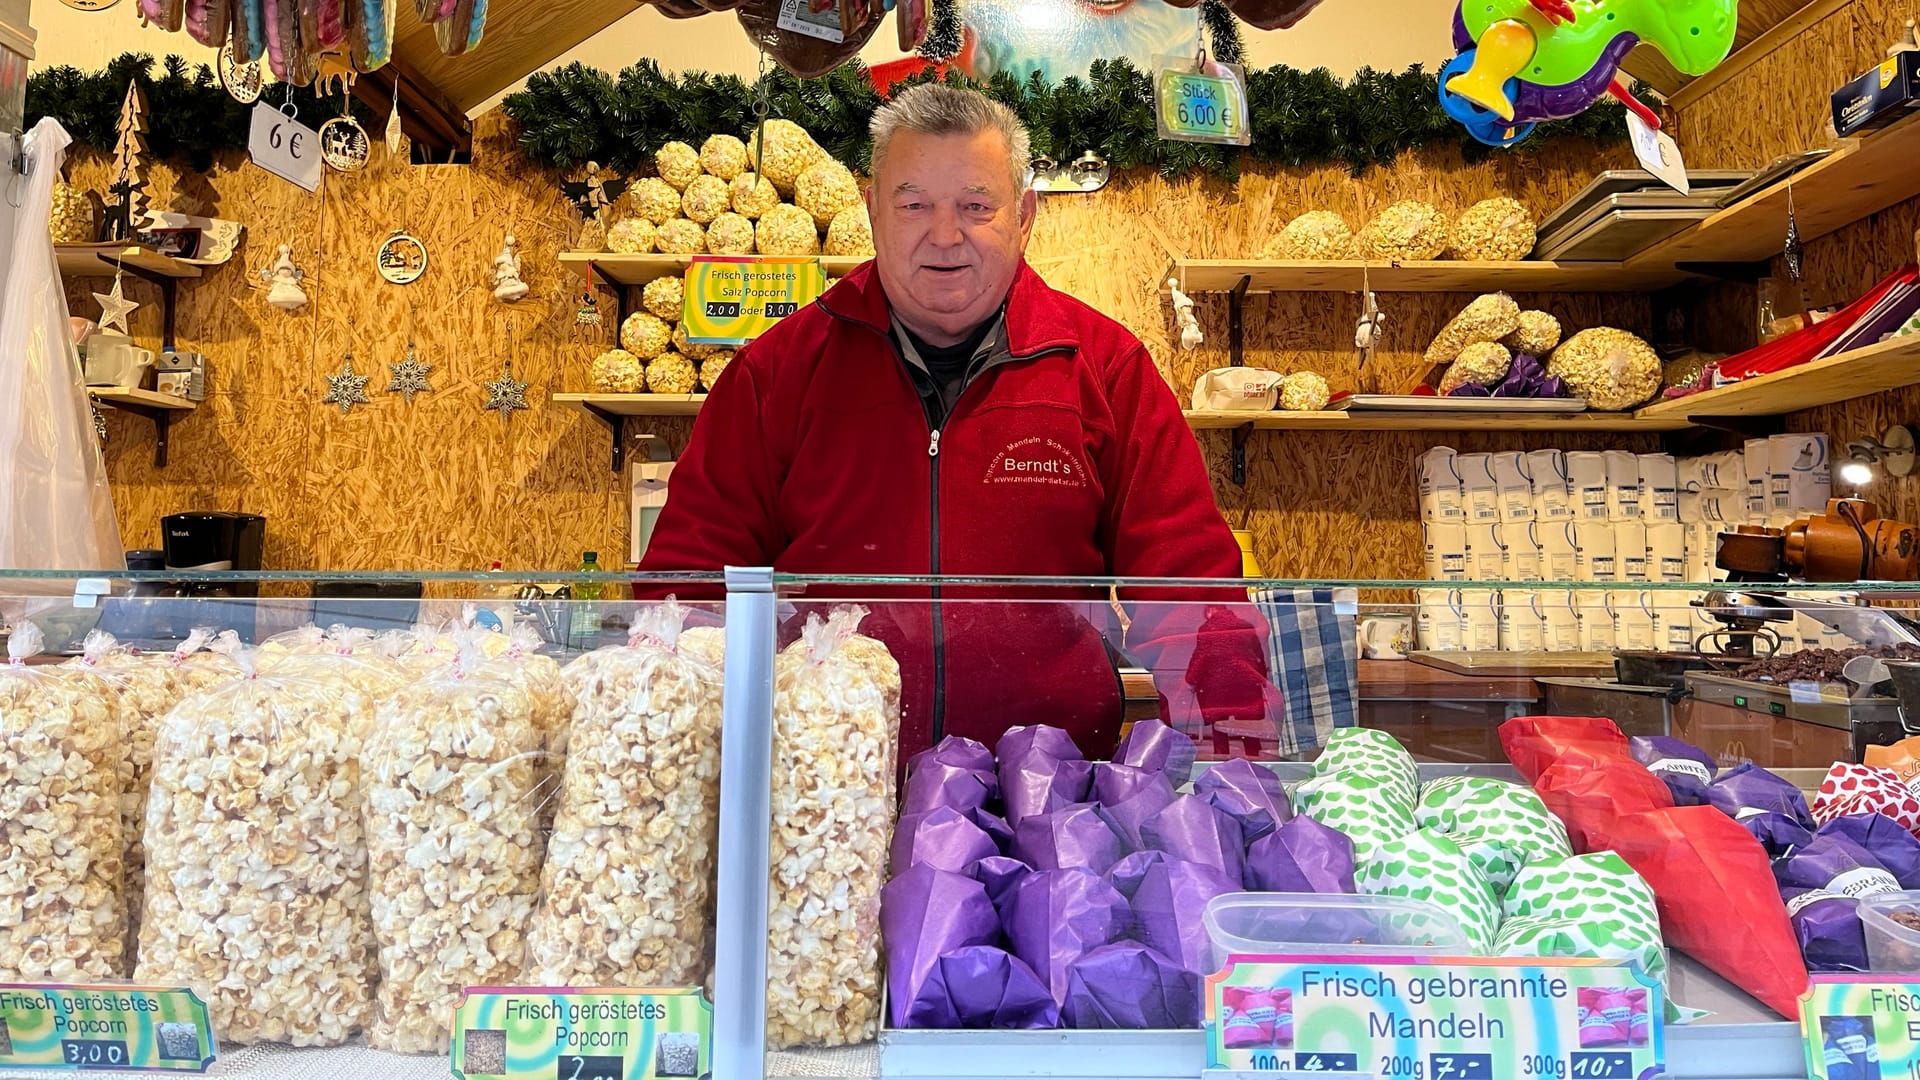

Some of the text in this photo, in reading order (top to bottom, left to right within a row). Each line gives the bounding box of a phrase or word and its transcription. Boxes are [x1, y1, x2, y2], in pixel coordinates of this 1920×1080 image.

[1182, 83, 1216, 100] Stück
[1178, 103, 1233, 128] 6,00 €
[269, 123, 303, 159] 6 €
[711, 270, 797, 281] Frisch geröstetes
[722, 287, 787, 298] Salz Popcorn
[740, 305, 764, 316] oder
[767, 303, 794, 317] 3,00
[1006, 436, 1041, 452] Mandeln
[1004, 458, 1071, 474] Berndt's
[1302, 970, 1567, 1004] Frisch gebrannte
[0, 991, 159, 1015] Frisch geröstetes
[505, 999, 666, 1024] Frisch geröstetes
[54, 1016, 128, 1037] Popcorn
[1368, 1012, 1504, 1039] Mandeln
[555, 1026, 629, 1050] Popcorn
[67, 1043, 122, 1064] 3,00
[1249, 1055, 1290, 1071] 100g
[1381, 1055, 1424, 1080] 200g
[1523, 1054, 1566, 1080] 300g
[1573, 1057, 1625, 1077] 10,-
